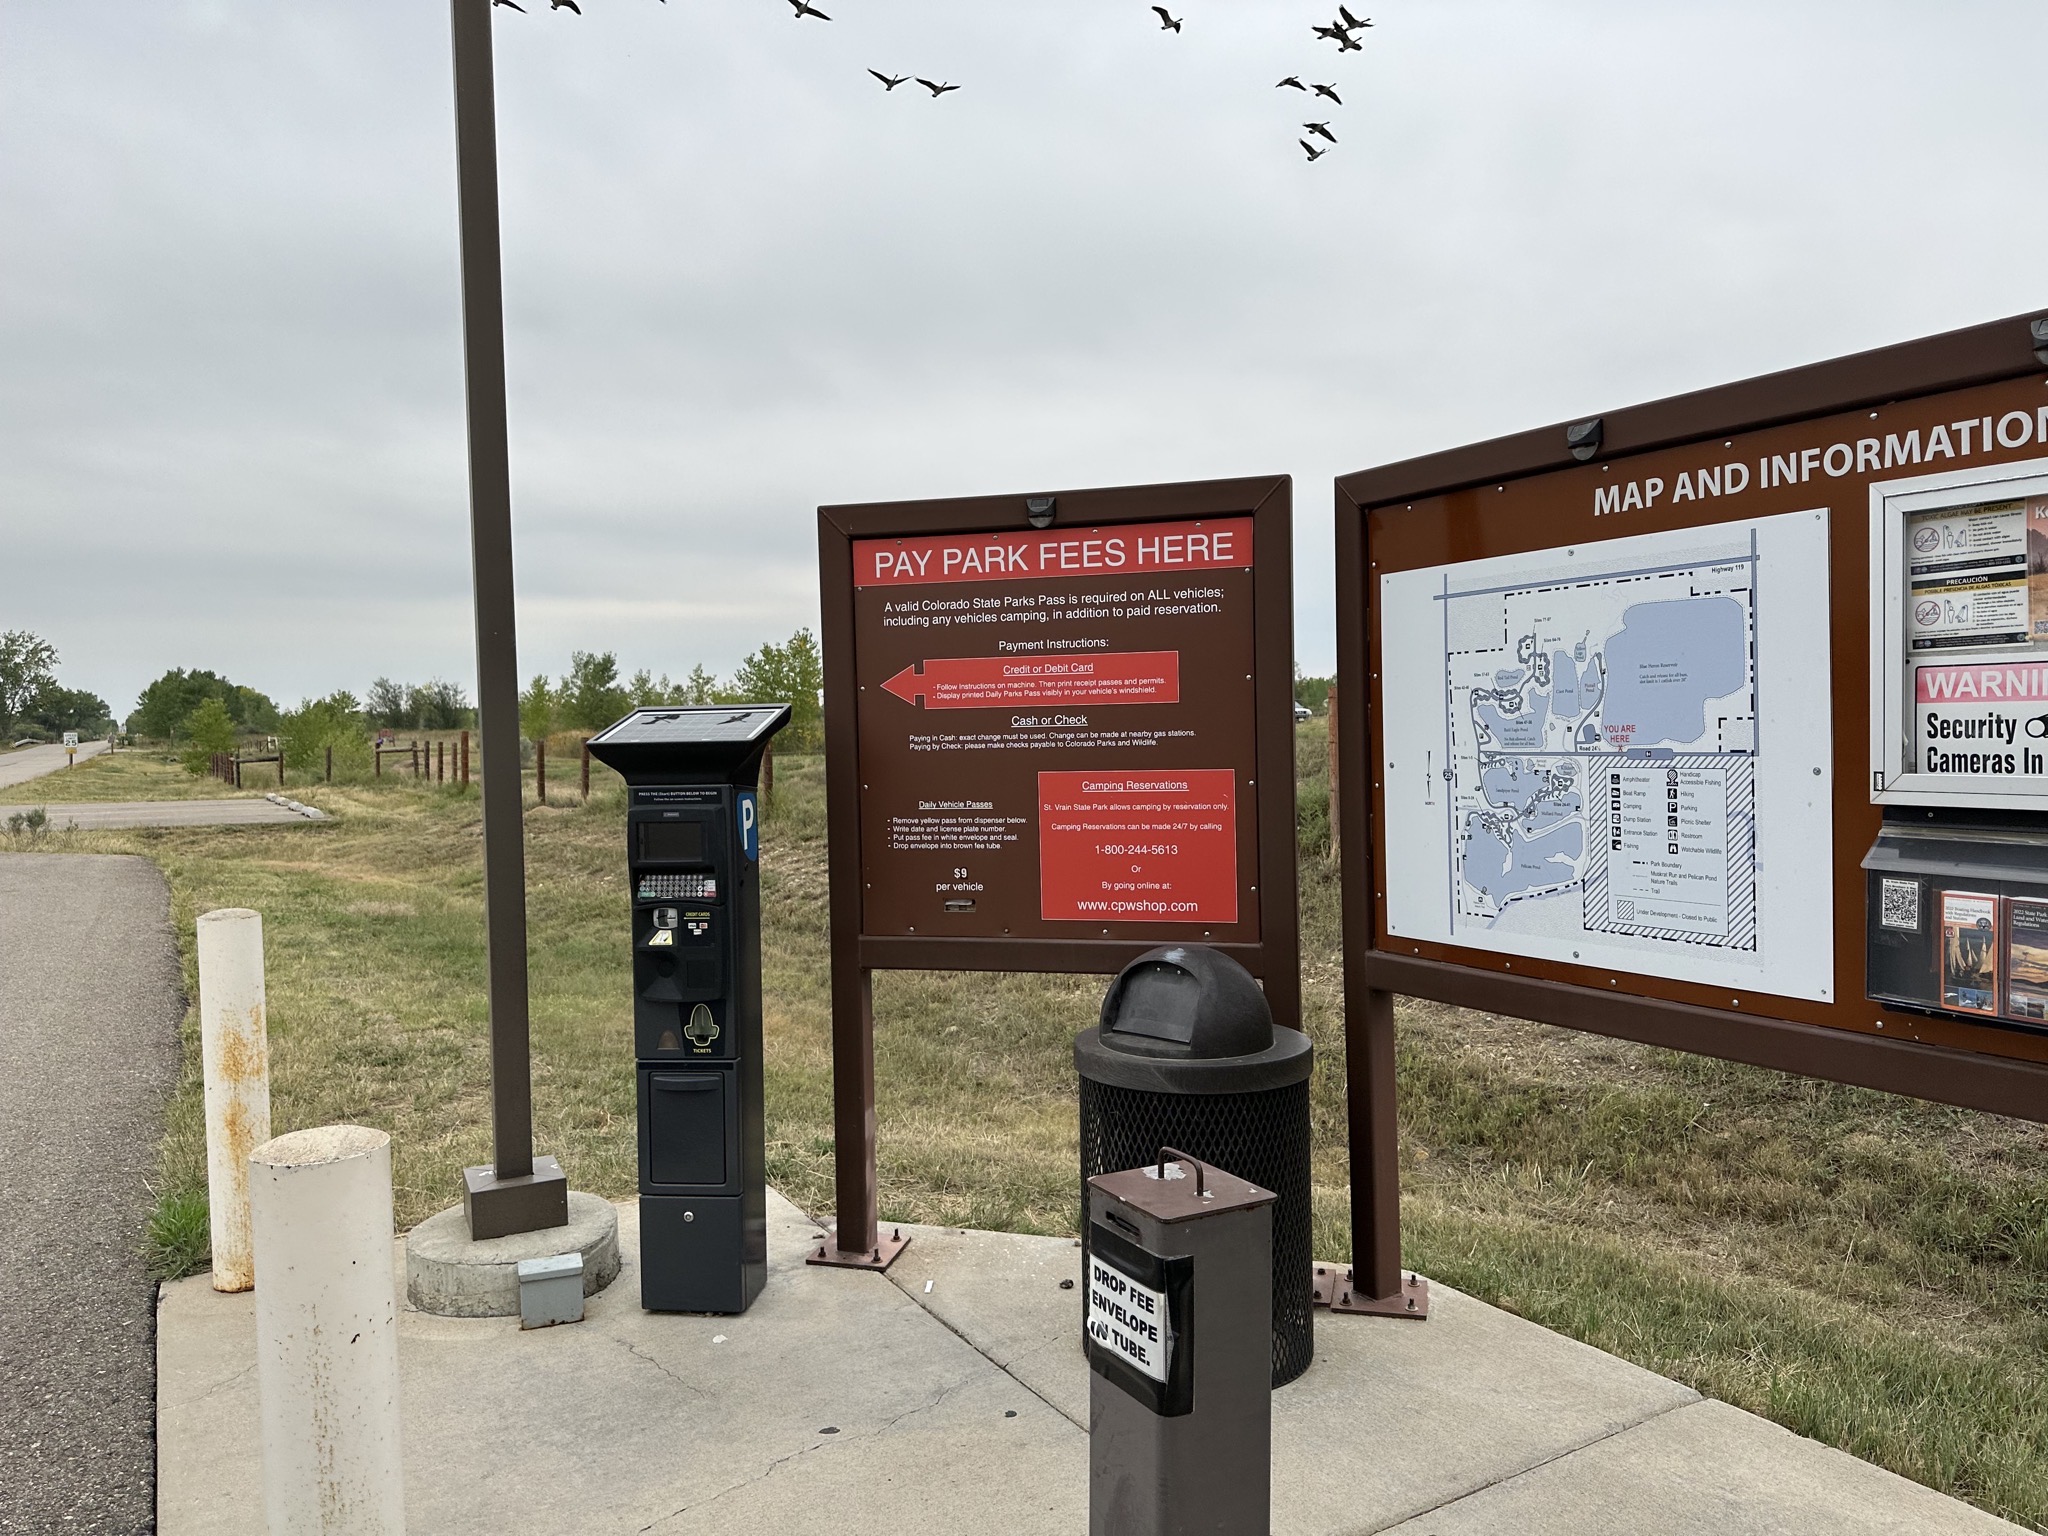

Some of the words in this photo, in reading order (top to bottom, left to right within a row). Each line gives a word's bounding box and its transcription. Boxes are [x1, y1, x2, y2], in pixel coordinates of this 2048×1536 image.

[1594, 478, 1664, 516] MAP
[1673, 463, 1749, 504] AND
[1984, 504, 2011, 512] PRESENT
[876, 550, 932, 578] PAY
[944, 545, 1028, 574] PARK
[1040, 539, 1125, 569] FEES
[1138, 532, 1233, 564] HERE
[1711, 566, 1734, 574] Highway
[1946, 576, 1988, 585] PRECAUCIÓN
[885, 602, 892, 612] A
[895, 601, 918, 611] valid
[922, 599, 969, 610] Colorado
[973, 598, 1000, 608] State
[1005, 596, 1035, 607] Parks
[1039, 595, 1065, 605] Pass
[1069, 594, 1077, 604] is
[1082, 591, 1126, 605] required
[1130, 593, 1144, 605] on
[1148, 589, 1170, 605] ALL
[1174, 587, 1223, 603] vehicles;
[884, 615, 929, 627] including
[933, 616, 951, 626] any
[954, 613, 997, 623] vehicles
[1001, 610, 1049, 623] camping,
[1053, 609, 1062, 619] in
[1066, 608, 1109, 618] addition
[1113, 607, 1123, 616] to
[1127, 605, 1150, 618] paid
[1155, 602, 1221, 615] reservation.
[999, 640, 1043, 652] Payment
[1047, 638, 1108, 648] Instructions:
[1071, 663, 1093, 671] Card
[1925, 670, 2048, 699] WARNI
[1012, 716, 1038, 725] Cash
[1055, 715, 1087, 724] Check
[1604, 725, 1619, 733] YOU
[1927, 712, 2017, 744] Security
[1049, 732, 1074, 740] Change
[1928, 747, 2015, 774] Cameras
[2025, 748, 2043, 774] In
[1082, 781, 1123, 789] Camping
[1127, 781, 1187, 789] Reservations
[743, 800, 753, 850] P
[1096, 845, 1178, 854] 1-800-244-5613
[954, 868, 967, 878] $9
[936, 884, 950, 892] per
[953, 882, 983, 891] vehicle
[1102, 882, 1112, 890] By
[1114, 882, 1135, 890] going
[1078, 900, 1197, 914] www.cpwshop.com
[1094, 1265, 1126, 1295] DROP
[1130, 1287, 1154, 1314] FEE
[1092, 1289, 1157, 1343] ENVELOPE
[1091, 1321, 1108, 1340] IN
[1112, 1330, 1150, 1366] TUBE.
